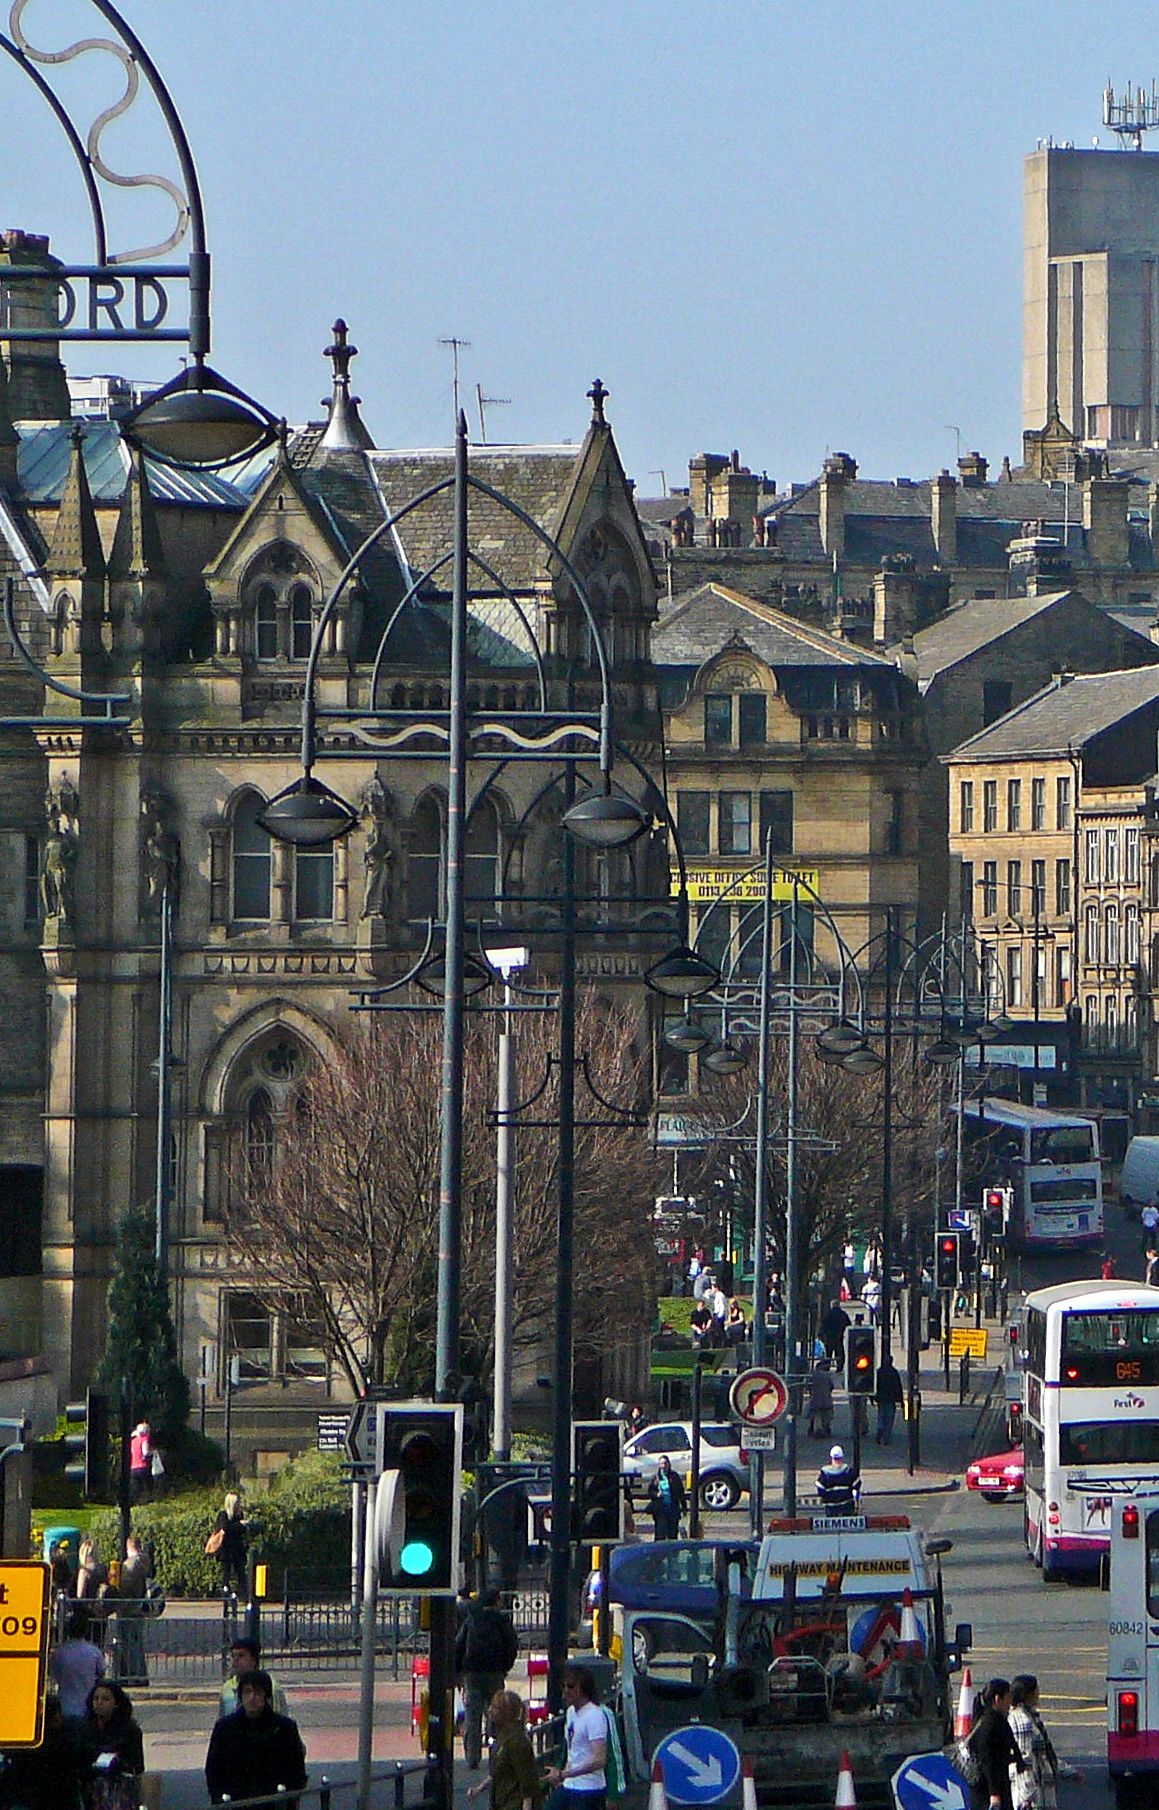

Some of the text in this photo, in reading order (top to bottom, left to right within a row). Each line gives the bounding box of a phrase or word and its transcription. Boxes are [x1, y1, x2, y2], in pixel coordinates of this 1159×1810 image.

[750, 871, 778, 884] SUIE
[1114, 1399, 1132, 1408] First
[814, 1519, 865, 1529] SIEMENS
[826, 1559, 911, 1575] MANTENANCE
[1109, 1622, 1143, 1636] 60842
